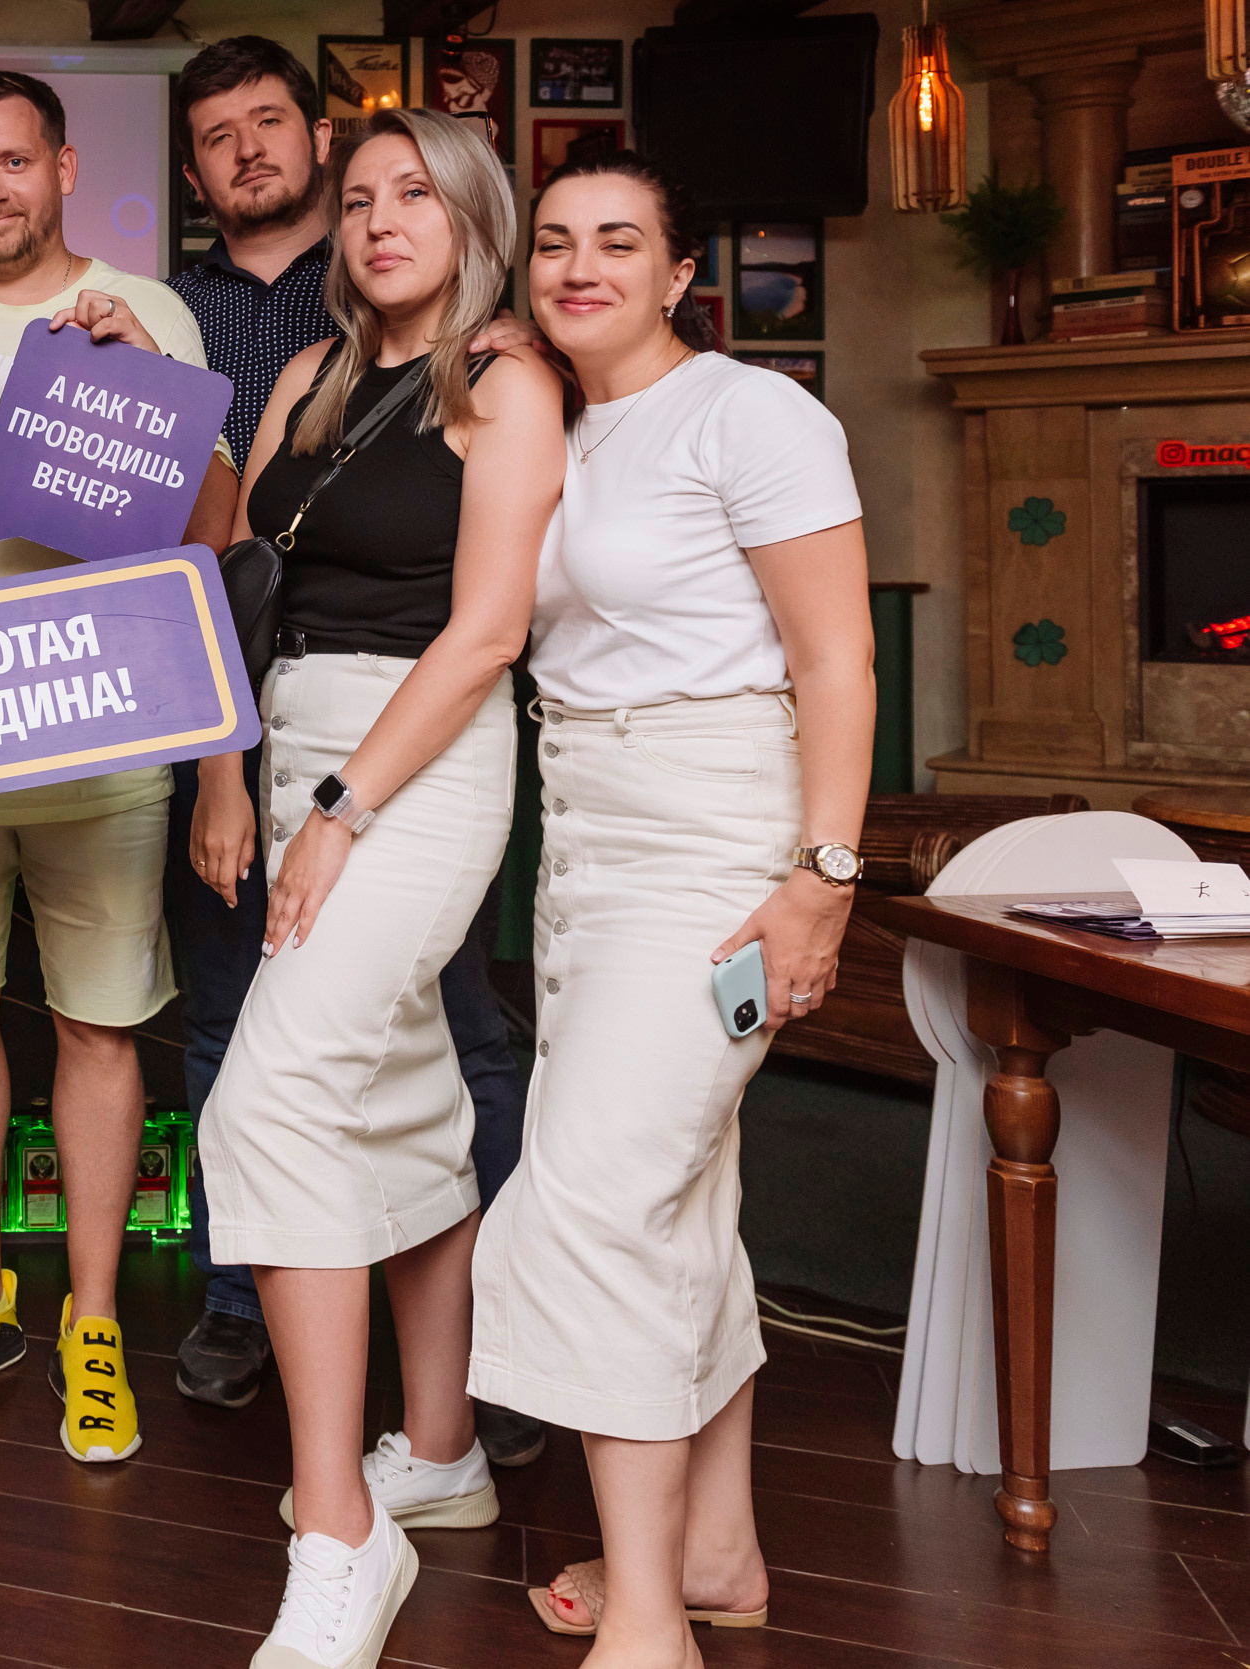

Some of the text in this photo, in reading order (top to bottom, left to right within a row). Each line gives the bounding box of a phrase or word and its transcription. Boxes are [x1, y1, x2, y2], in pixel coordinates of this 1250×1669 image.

[1185, 152, 1243, 171] DOUBLE
[45, 375, 177, 439] А КАК ТЫ
[7, 406, 185, 489] ПРОВОДИШЬ
[31, 461, 132, 517] ВЕЧЕР?
[78, 1331, 116, 1432] RACE
